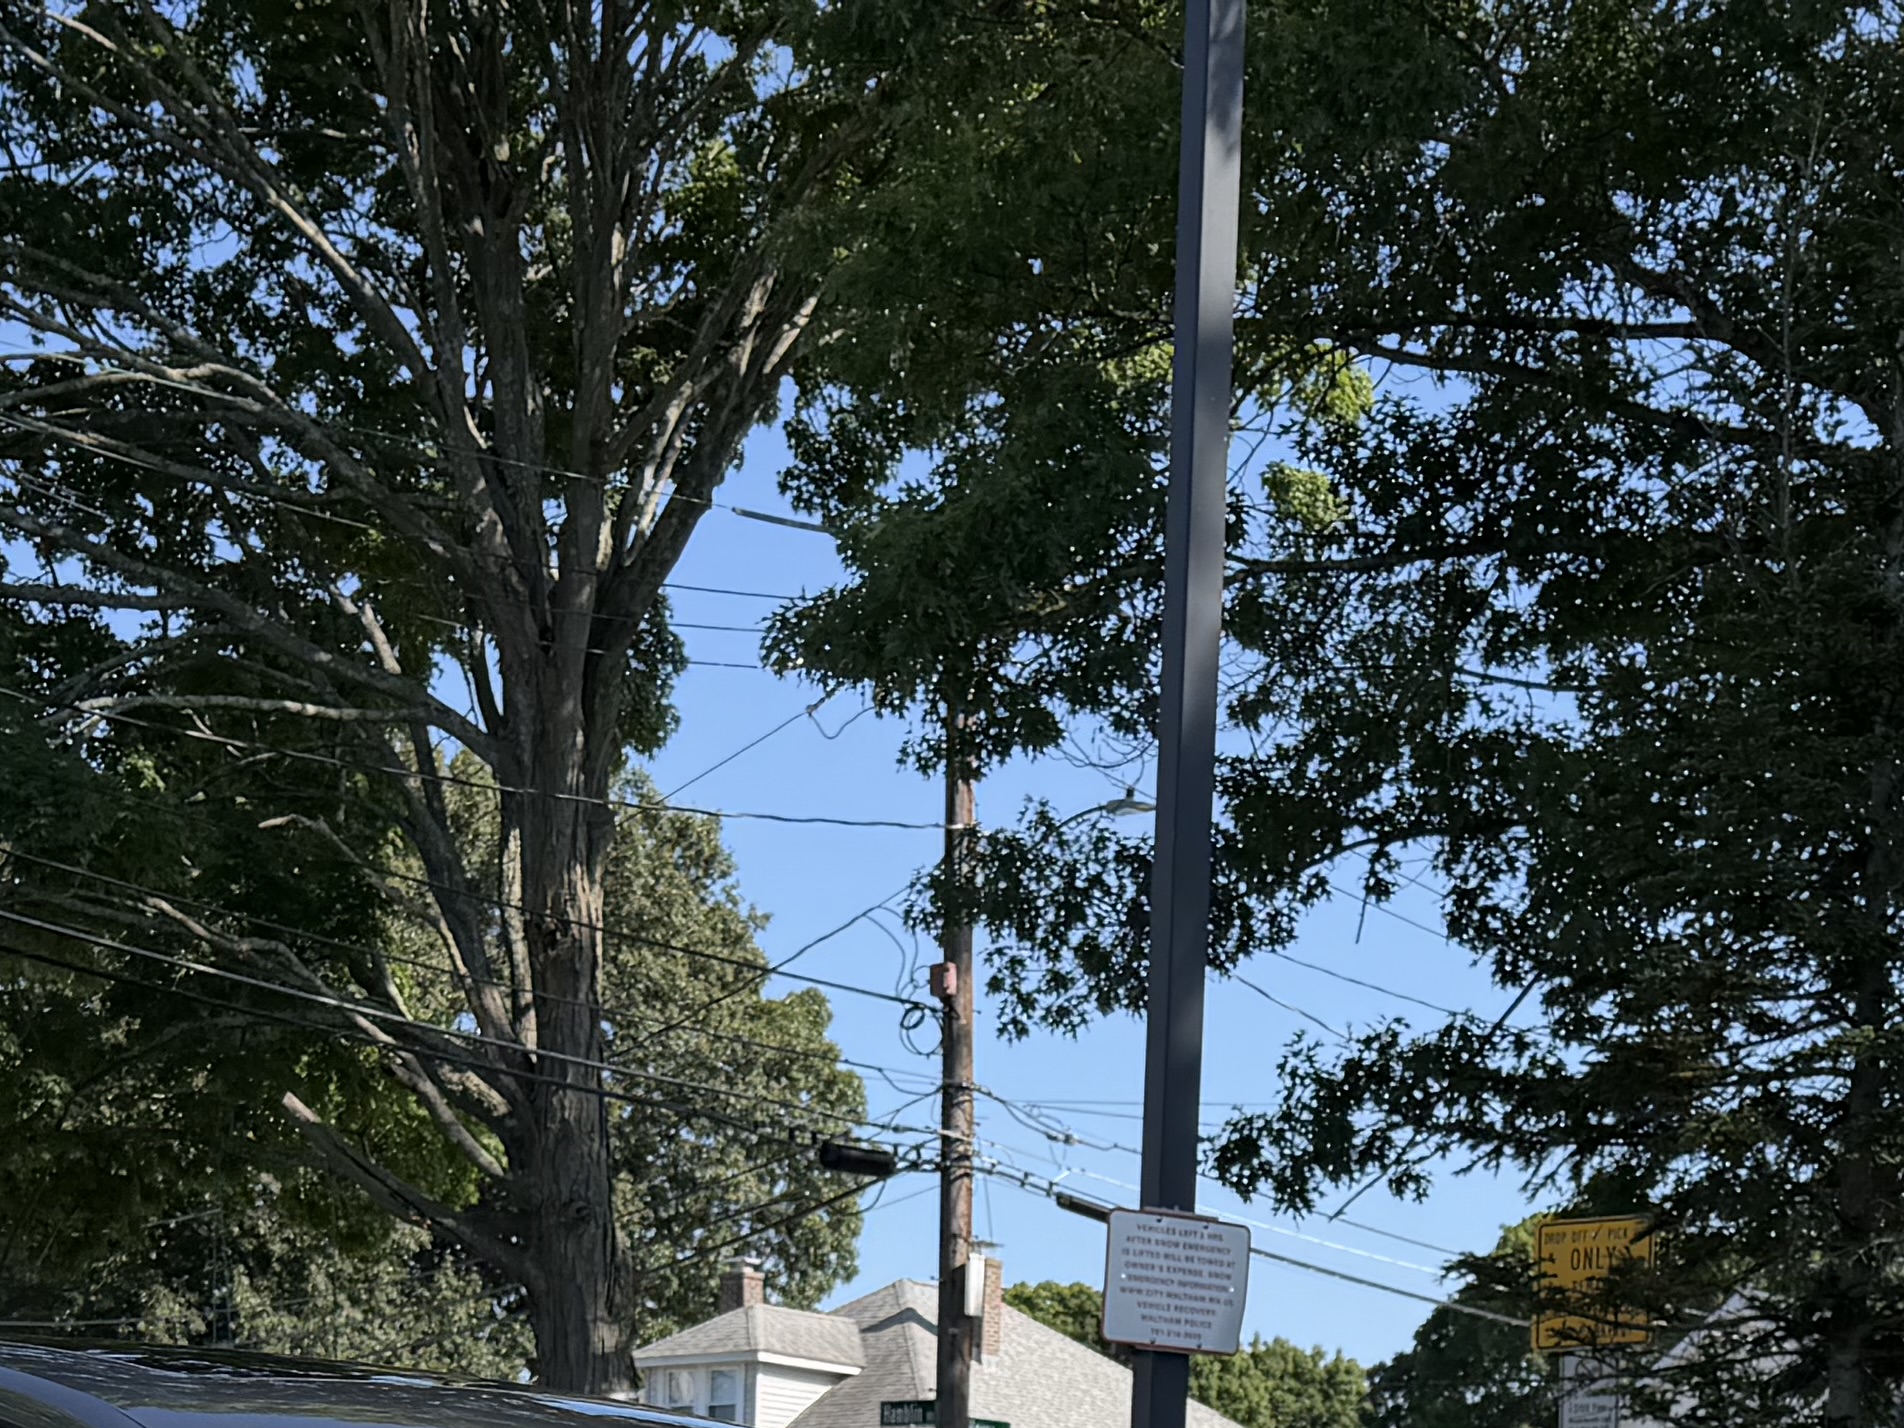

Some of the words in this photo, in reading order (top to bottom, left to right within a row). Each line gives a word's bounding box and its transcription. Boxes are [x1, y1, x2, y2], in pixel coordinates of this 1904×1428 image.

[1137, 1224, 1176, 1236] VEHICLES
[1126, 1236, 1152, 1246] AFTER
[1155, 1239, 1180, 1250] SNOW
[1183, 1242, 1232, 1255] EMERGENCY
[1570, 1246, 1617, 1271] ONLY
